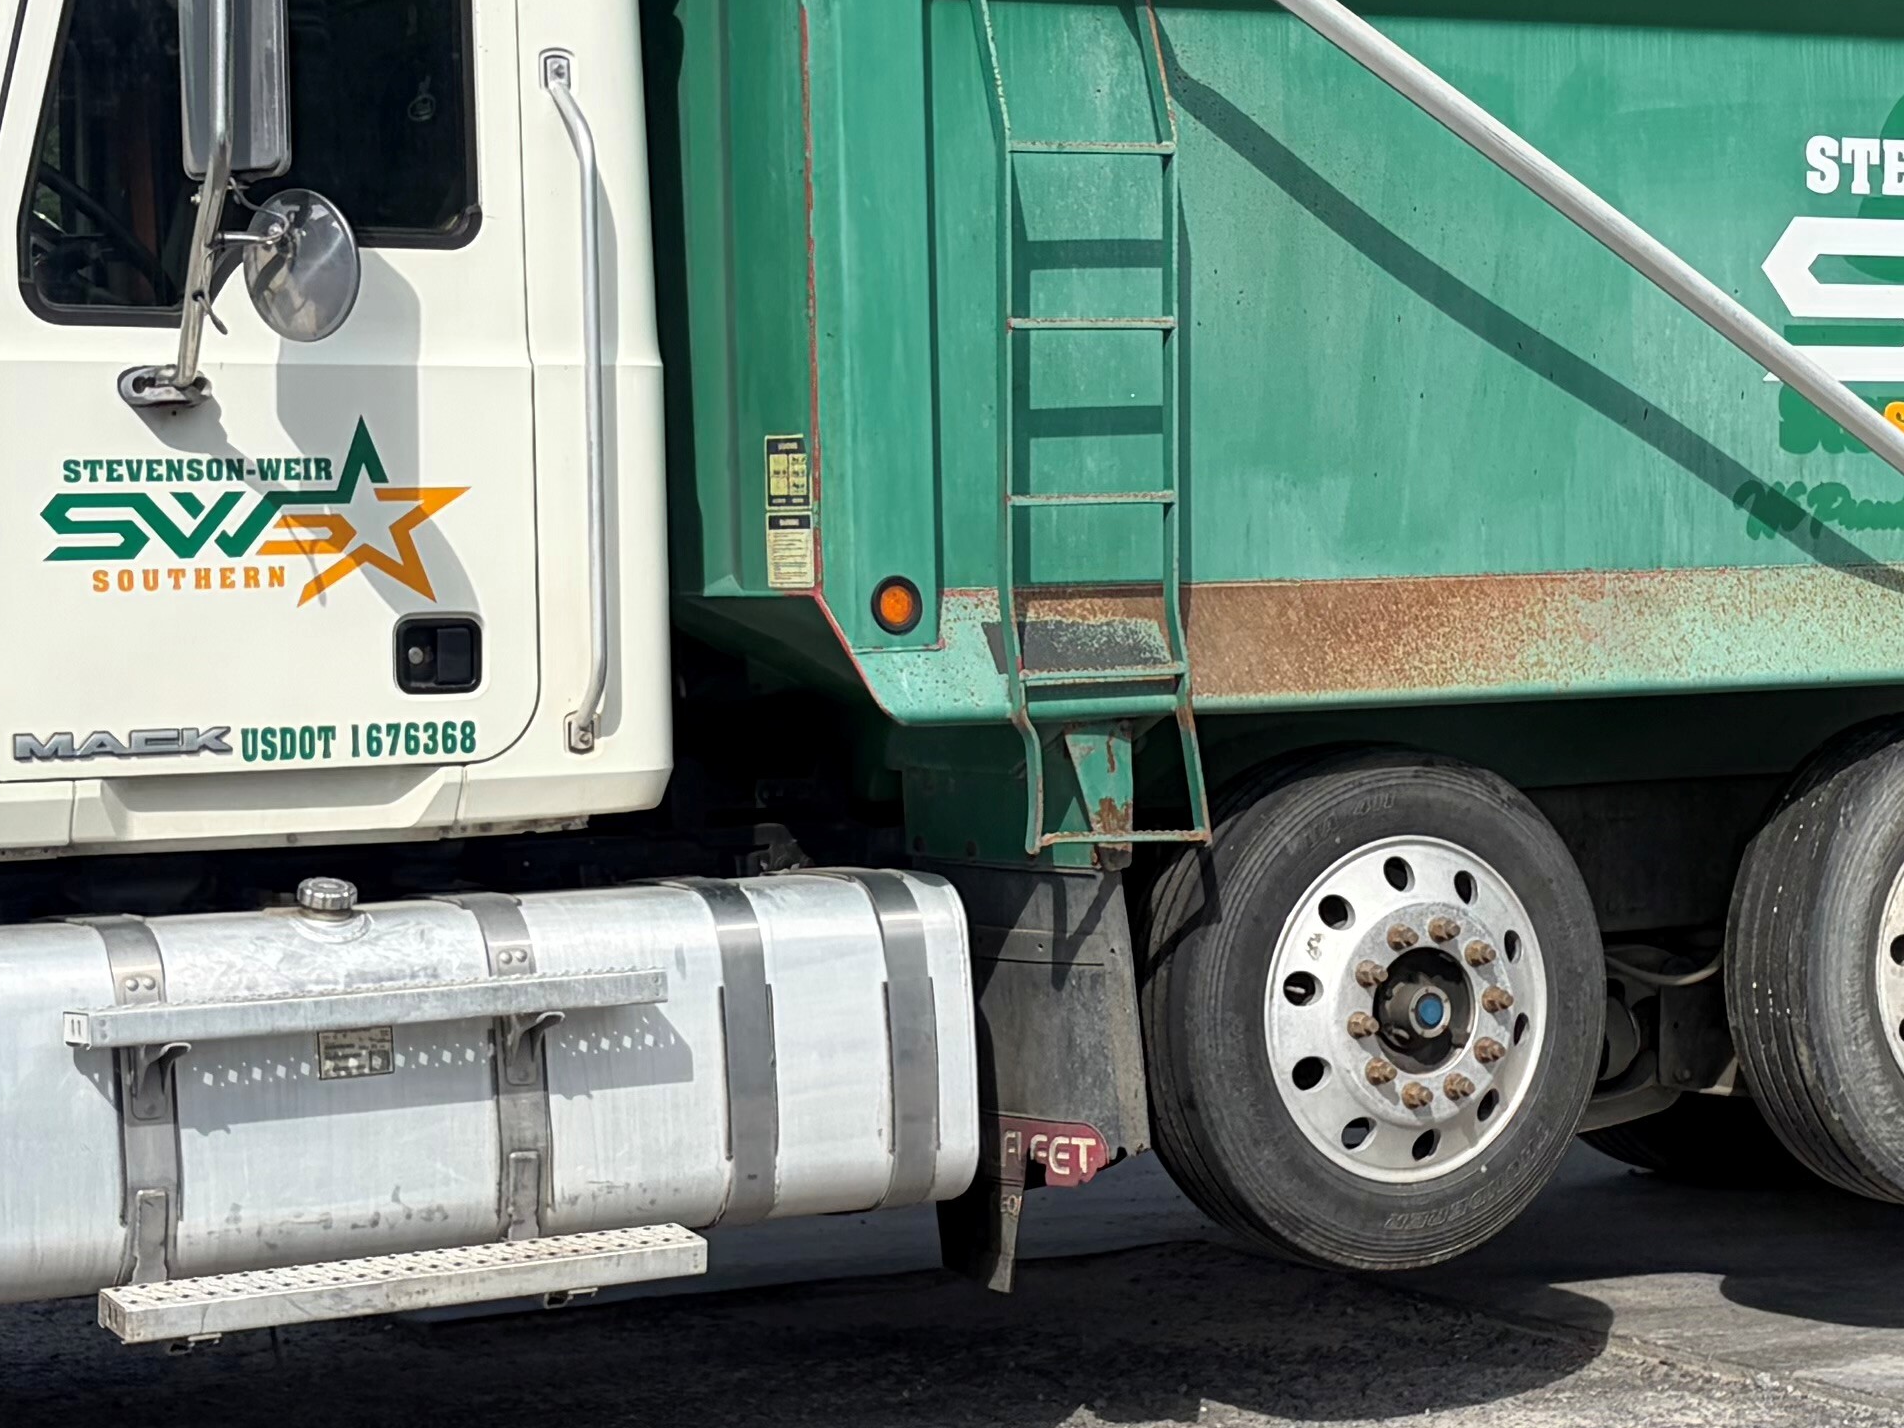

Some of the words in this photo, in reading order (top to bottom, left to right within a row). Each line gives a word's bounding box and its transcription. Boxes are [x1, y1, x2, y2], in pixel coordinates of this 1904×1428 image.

[63, 457, 333, 483] STEVENSON-WEIR
[93, 565, 286, 592] SOUTHERN
[13, 726, 234, 760] MACK
[241, 725, 336, 762] USDOT
[351, 720, 477, 759] 1676368
